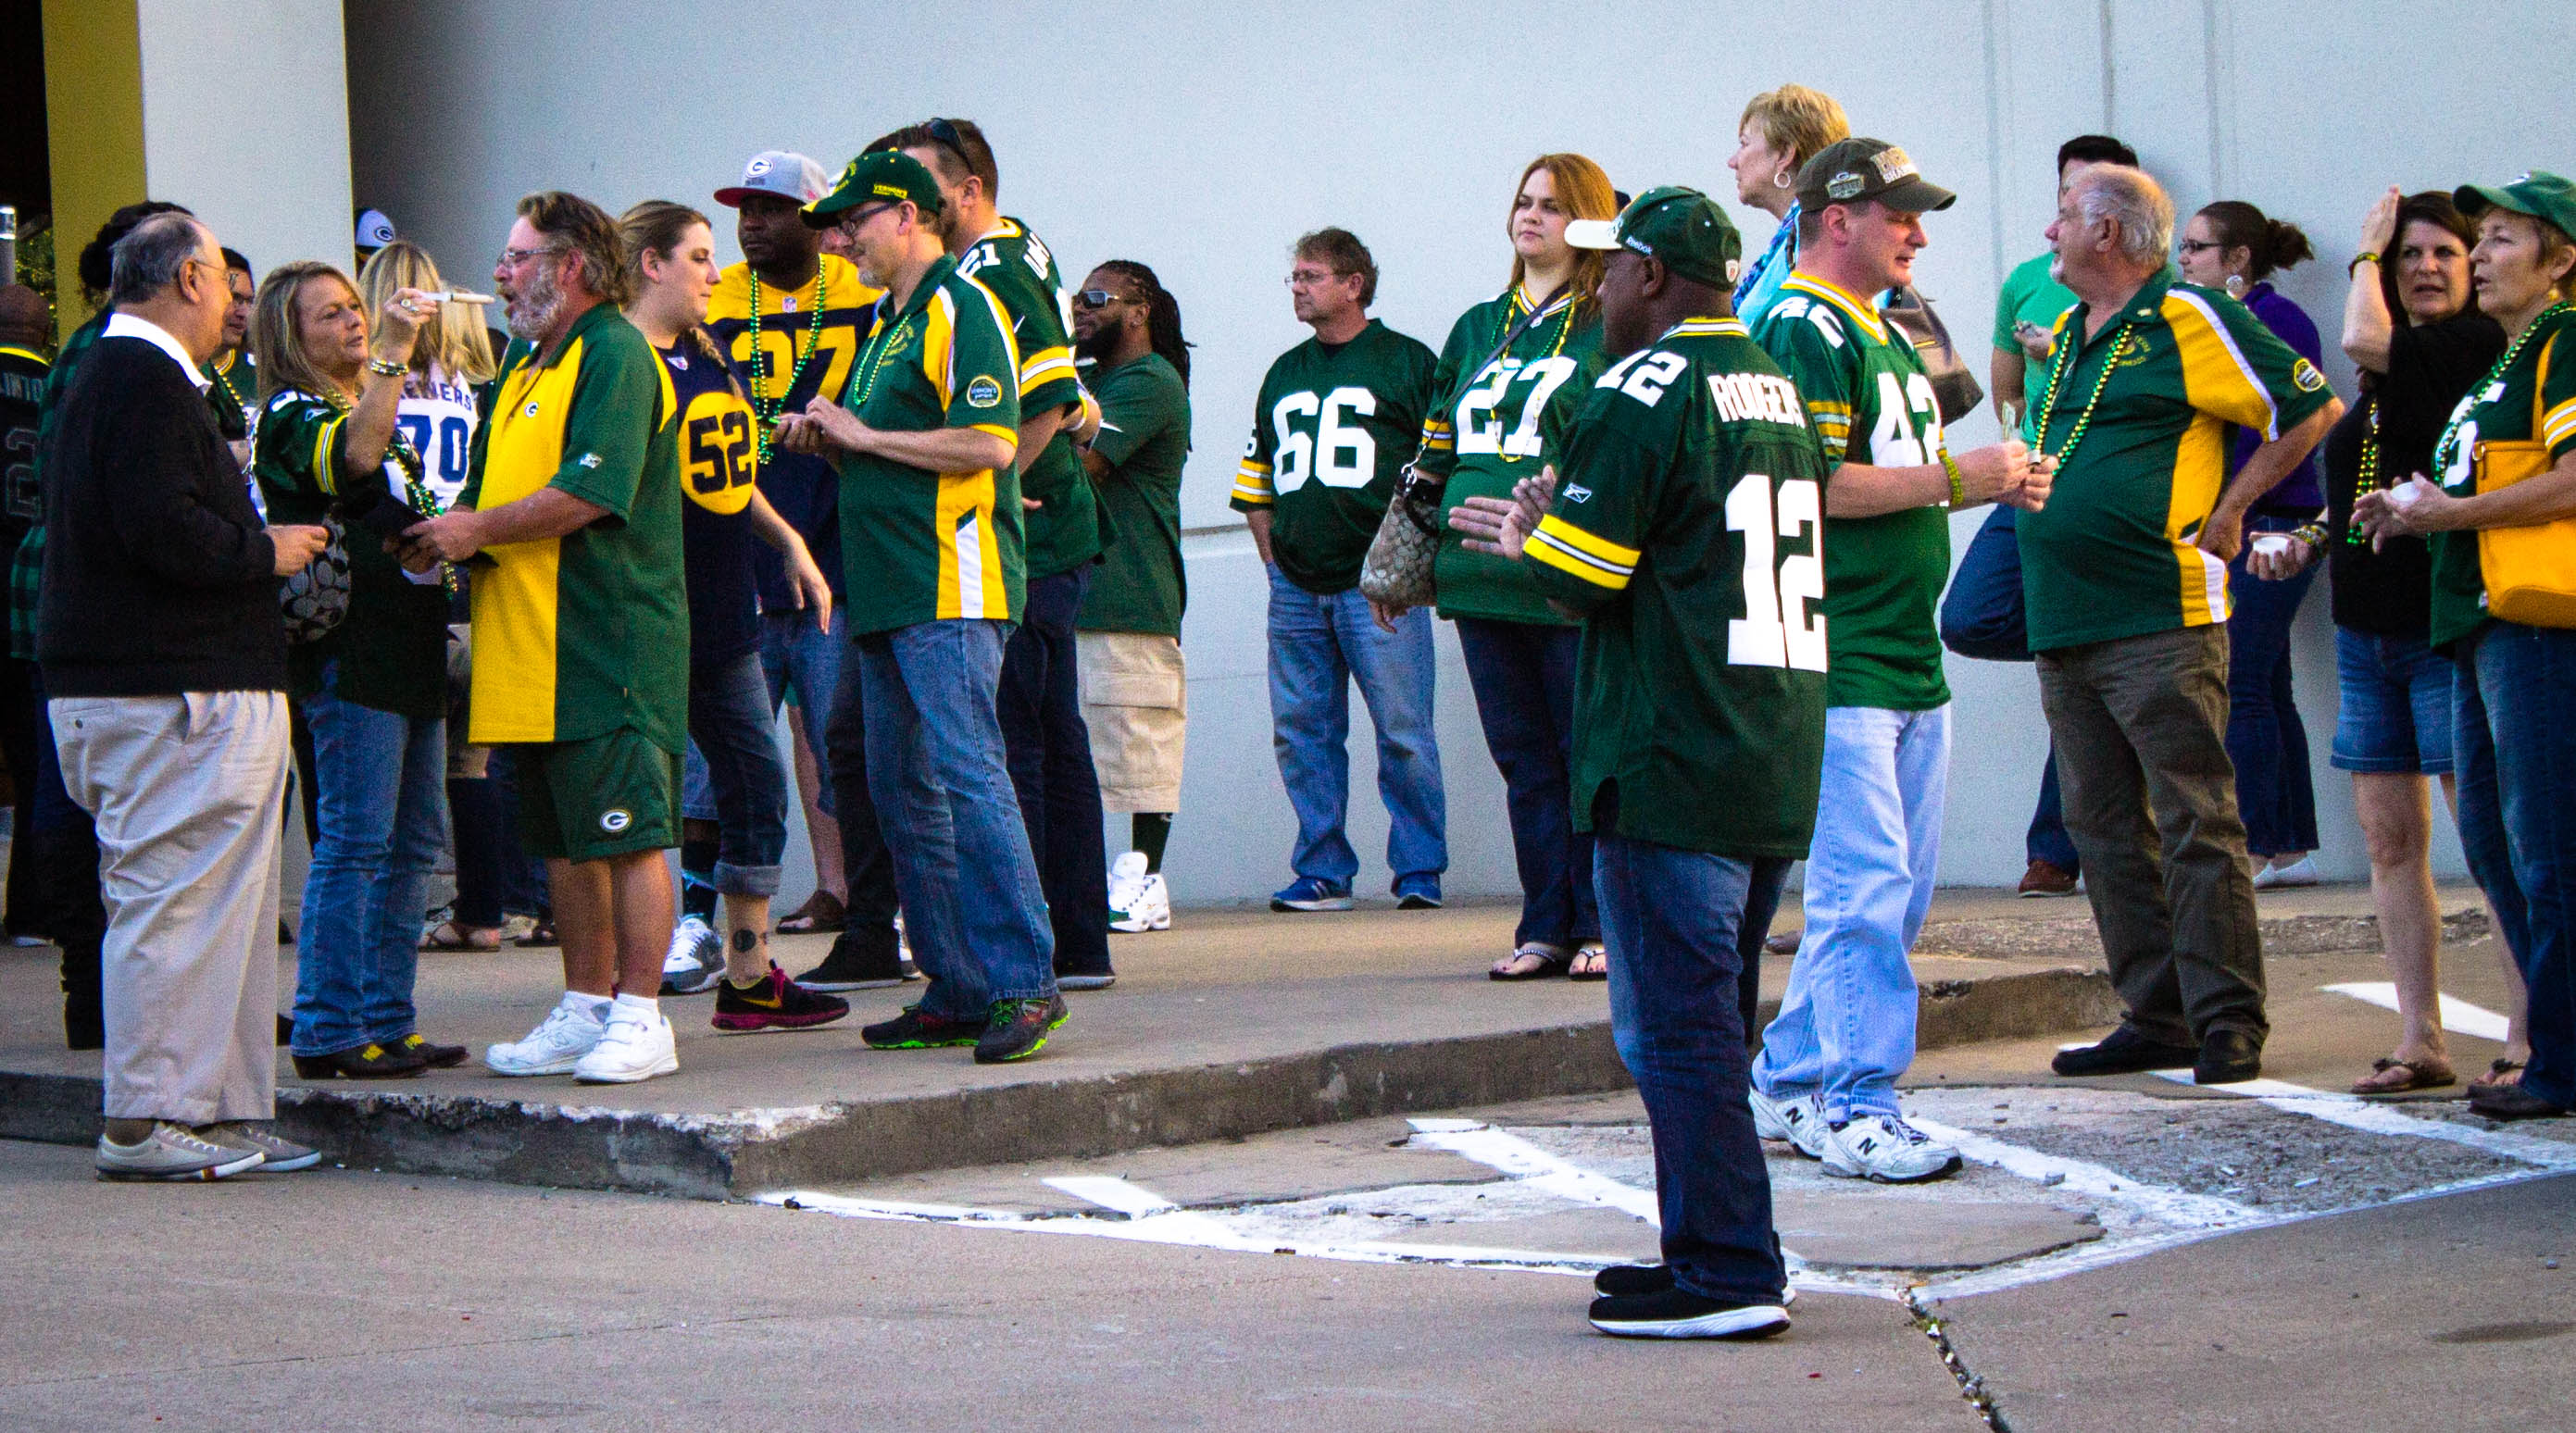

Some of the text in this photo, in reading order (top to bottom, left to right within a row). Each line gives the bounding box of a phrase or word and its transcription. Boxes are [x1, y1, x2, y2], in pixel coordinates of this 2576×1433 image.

[956, 243, 1002, 279] 21
[1626, 235, 1653, 255] Reebok
[1456, 355, 1578, 457] 27
[1594, 349, 1689, 407] 12
[396, 414, 469, 482] 70
[689, 410, 753, 493] 52
[1272, 387, 1378, 496] 66
[1725, 474, 1828, 674] 12
[600, 808, 632, 831] G
[1784, 1106, 1804, 1126] N
[1857, 1137, 1879, 1156] N
